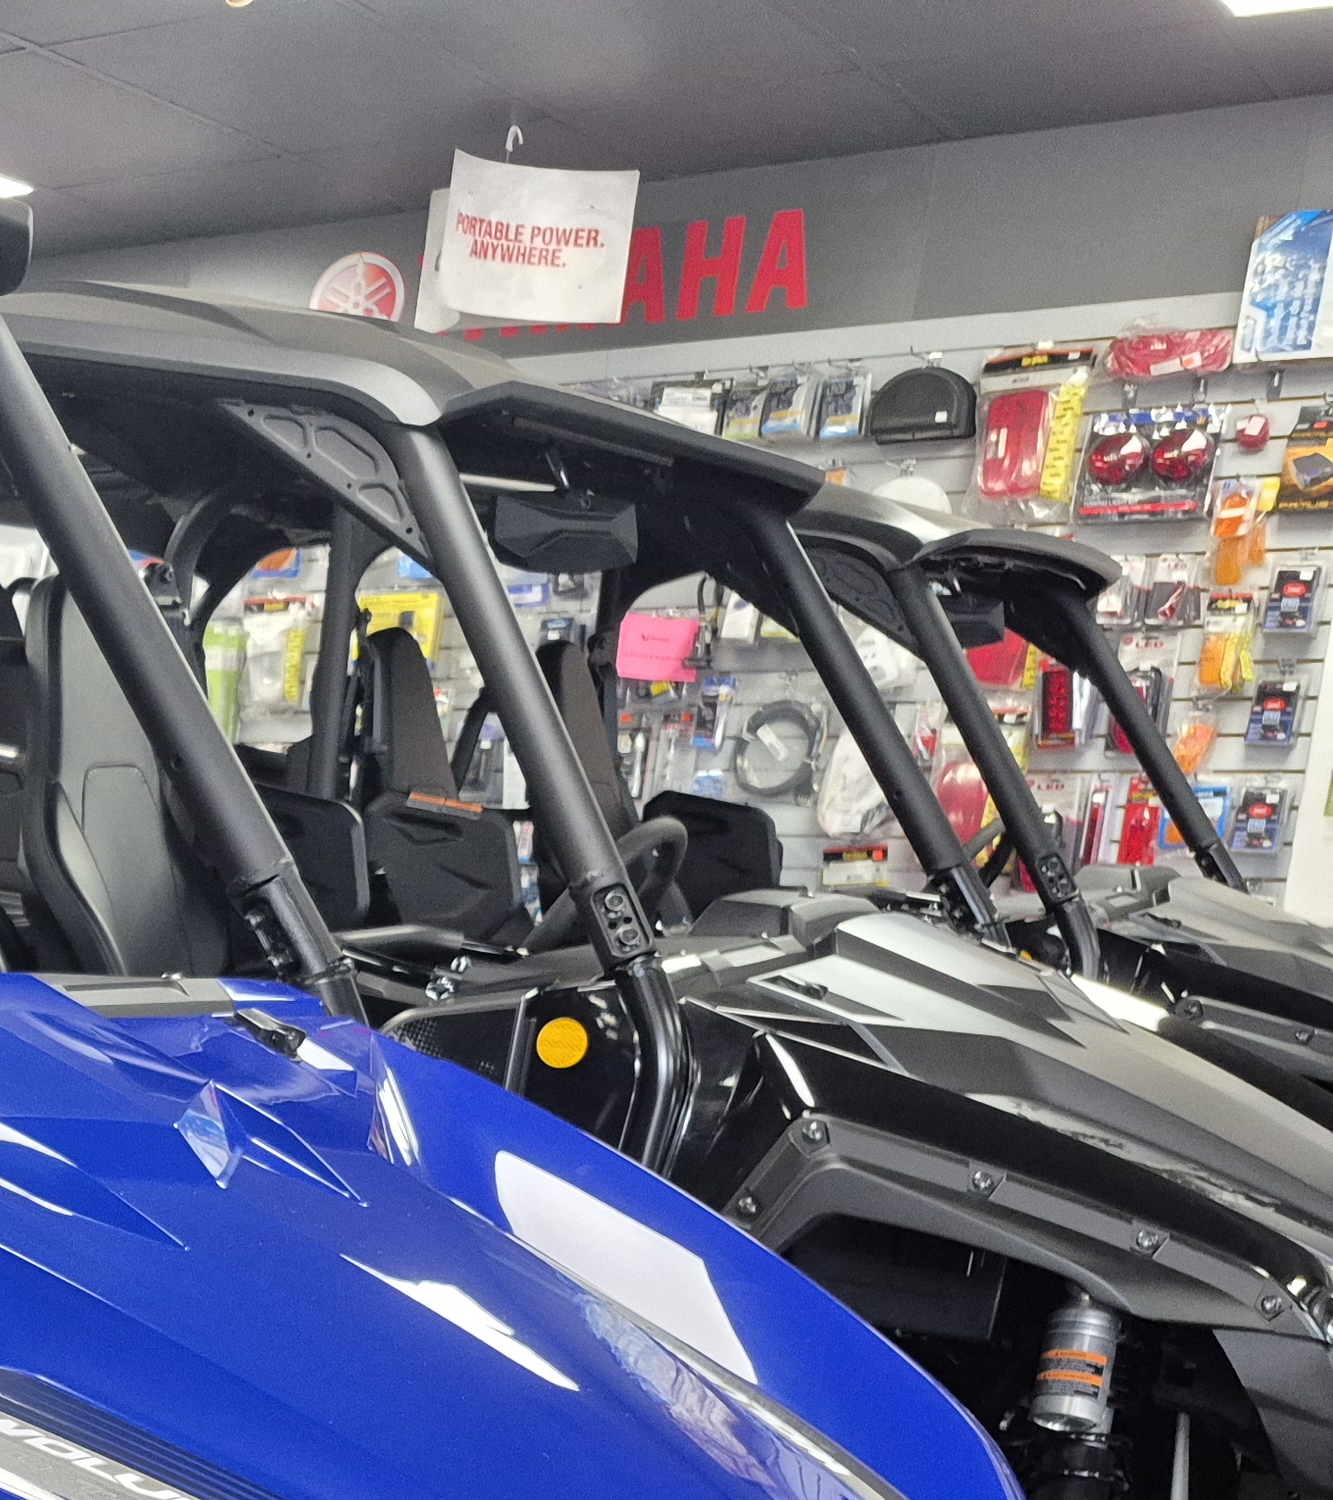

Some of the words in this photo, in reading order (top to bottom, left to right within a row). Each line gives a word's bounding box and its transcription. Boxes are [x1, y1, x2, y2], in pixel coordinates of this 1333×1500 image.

[456, 212, 525, 243] PORTABLE
[530, 226, 605, 248] POWER.
[469, 239, 566, 268] ANYWHERE.
